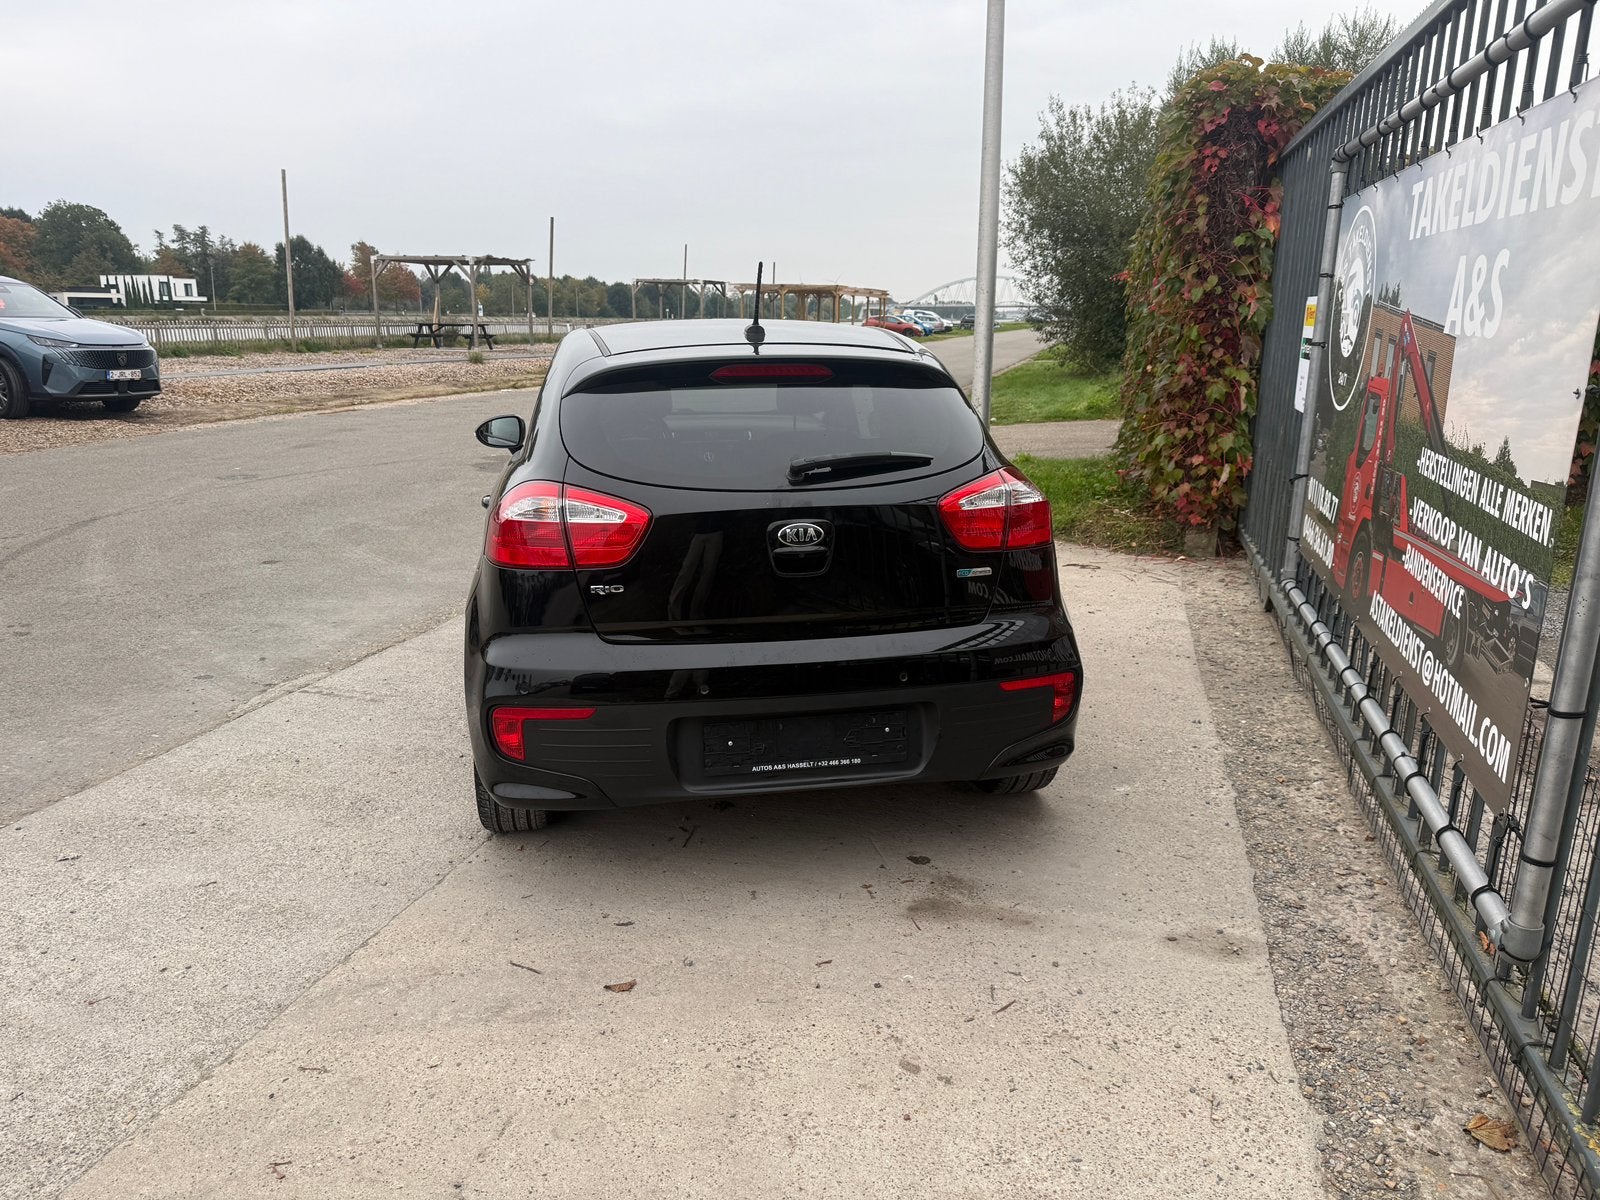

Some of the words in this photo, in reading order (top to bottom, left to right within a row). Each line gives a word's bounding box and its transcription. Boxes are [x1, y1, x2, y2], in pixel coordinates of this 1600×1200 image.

[1443, 248, 1510, 339] A&S
[1478, 477, 1504, 518] ALLE
[785, 527, 818, 542] KIA
[1457, 526, 1482, 572] VAN
[1481, 546, 1534, 610] AUTO'S
[590, 585, 624, 595] RIO
[1369, 589, 1511, 784] ASTAKELDIENST@HOTMAIL.COM
[787, 761, 814, 769] HASSELT
